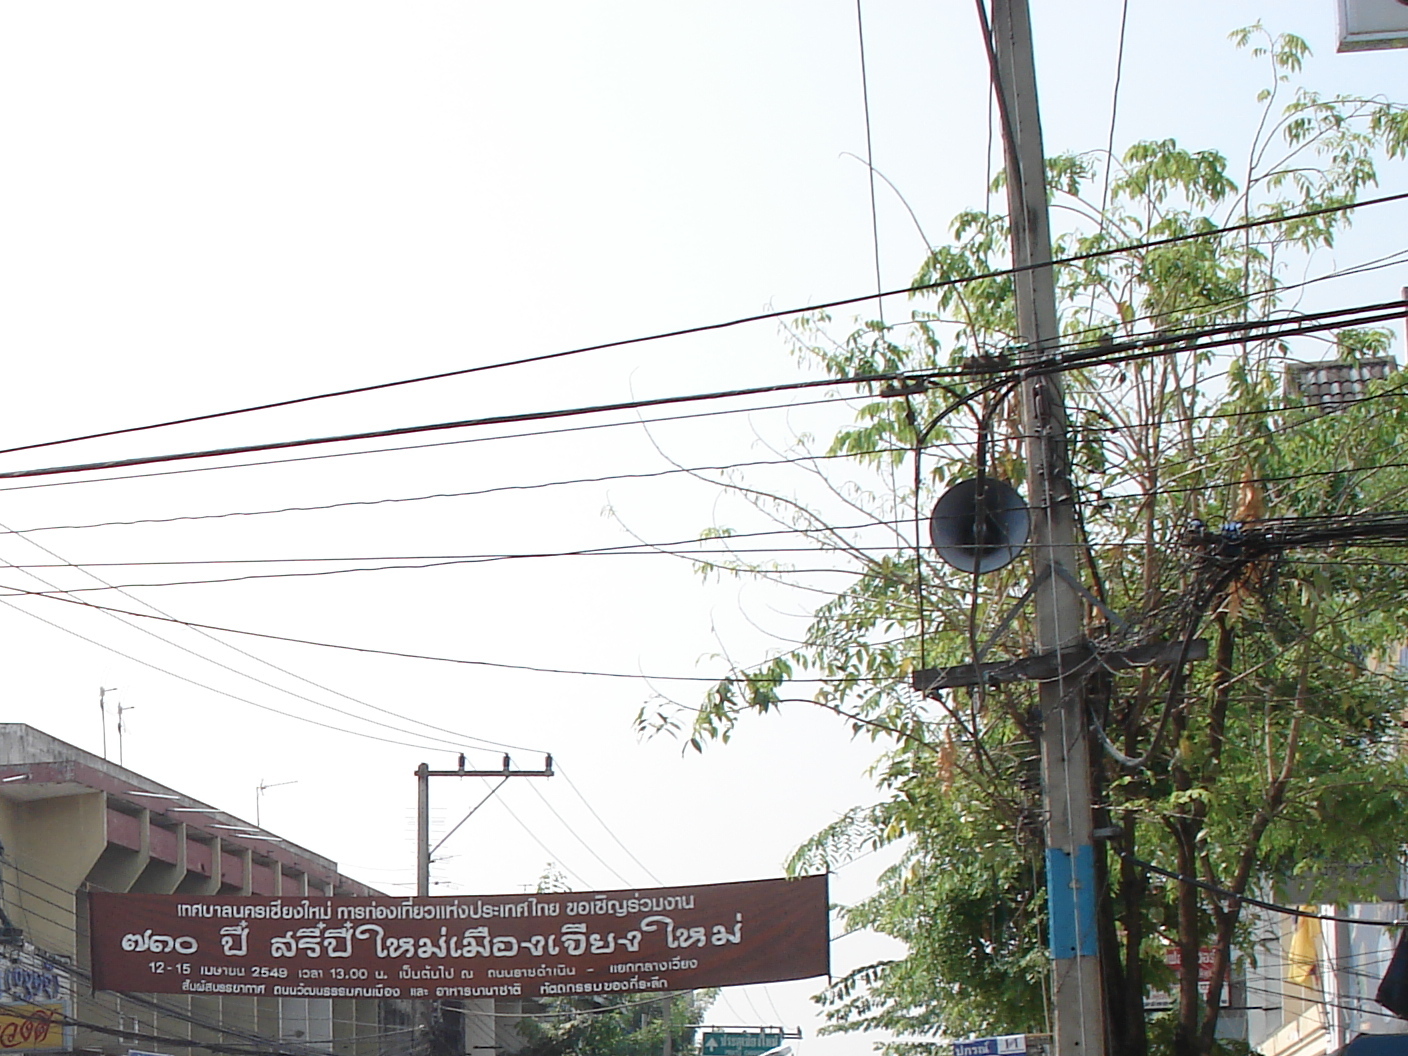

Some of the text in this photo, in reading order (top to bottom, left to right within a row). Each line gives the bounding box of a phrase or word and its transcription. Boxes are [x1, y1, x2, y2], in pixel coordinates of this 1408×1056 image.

[178, 893, 695, 920] เทศบาลนครเชียงใหม่ การท่องเที่ยวแห่งประเทศไทย ขอเชิญร่วมงาน
[200, 965, 246, 977] เมษายน
[251, 966, 288, 979] 2549
[298, 968, 324, 979] เวลา
[329, 967, 368, 980] 13.00
[374, 970, 389, 980] น.
[398, 963, 455, 980] เป็นต้นไป
[460, 969, 474, 980] ณ
[487, 964, 576, 979] ถนนราชดำเนิน
[609, 957, 699, 974] แยกกลางเวียง
[181, 981, 266, 996] สัมผัสบรรยากาศ
[409, 985, 429, 997] และ
[435, 982, 522, 997] อาหารนานาชาติ
